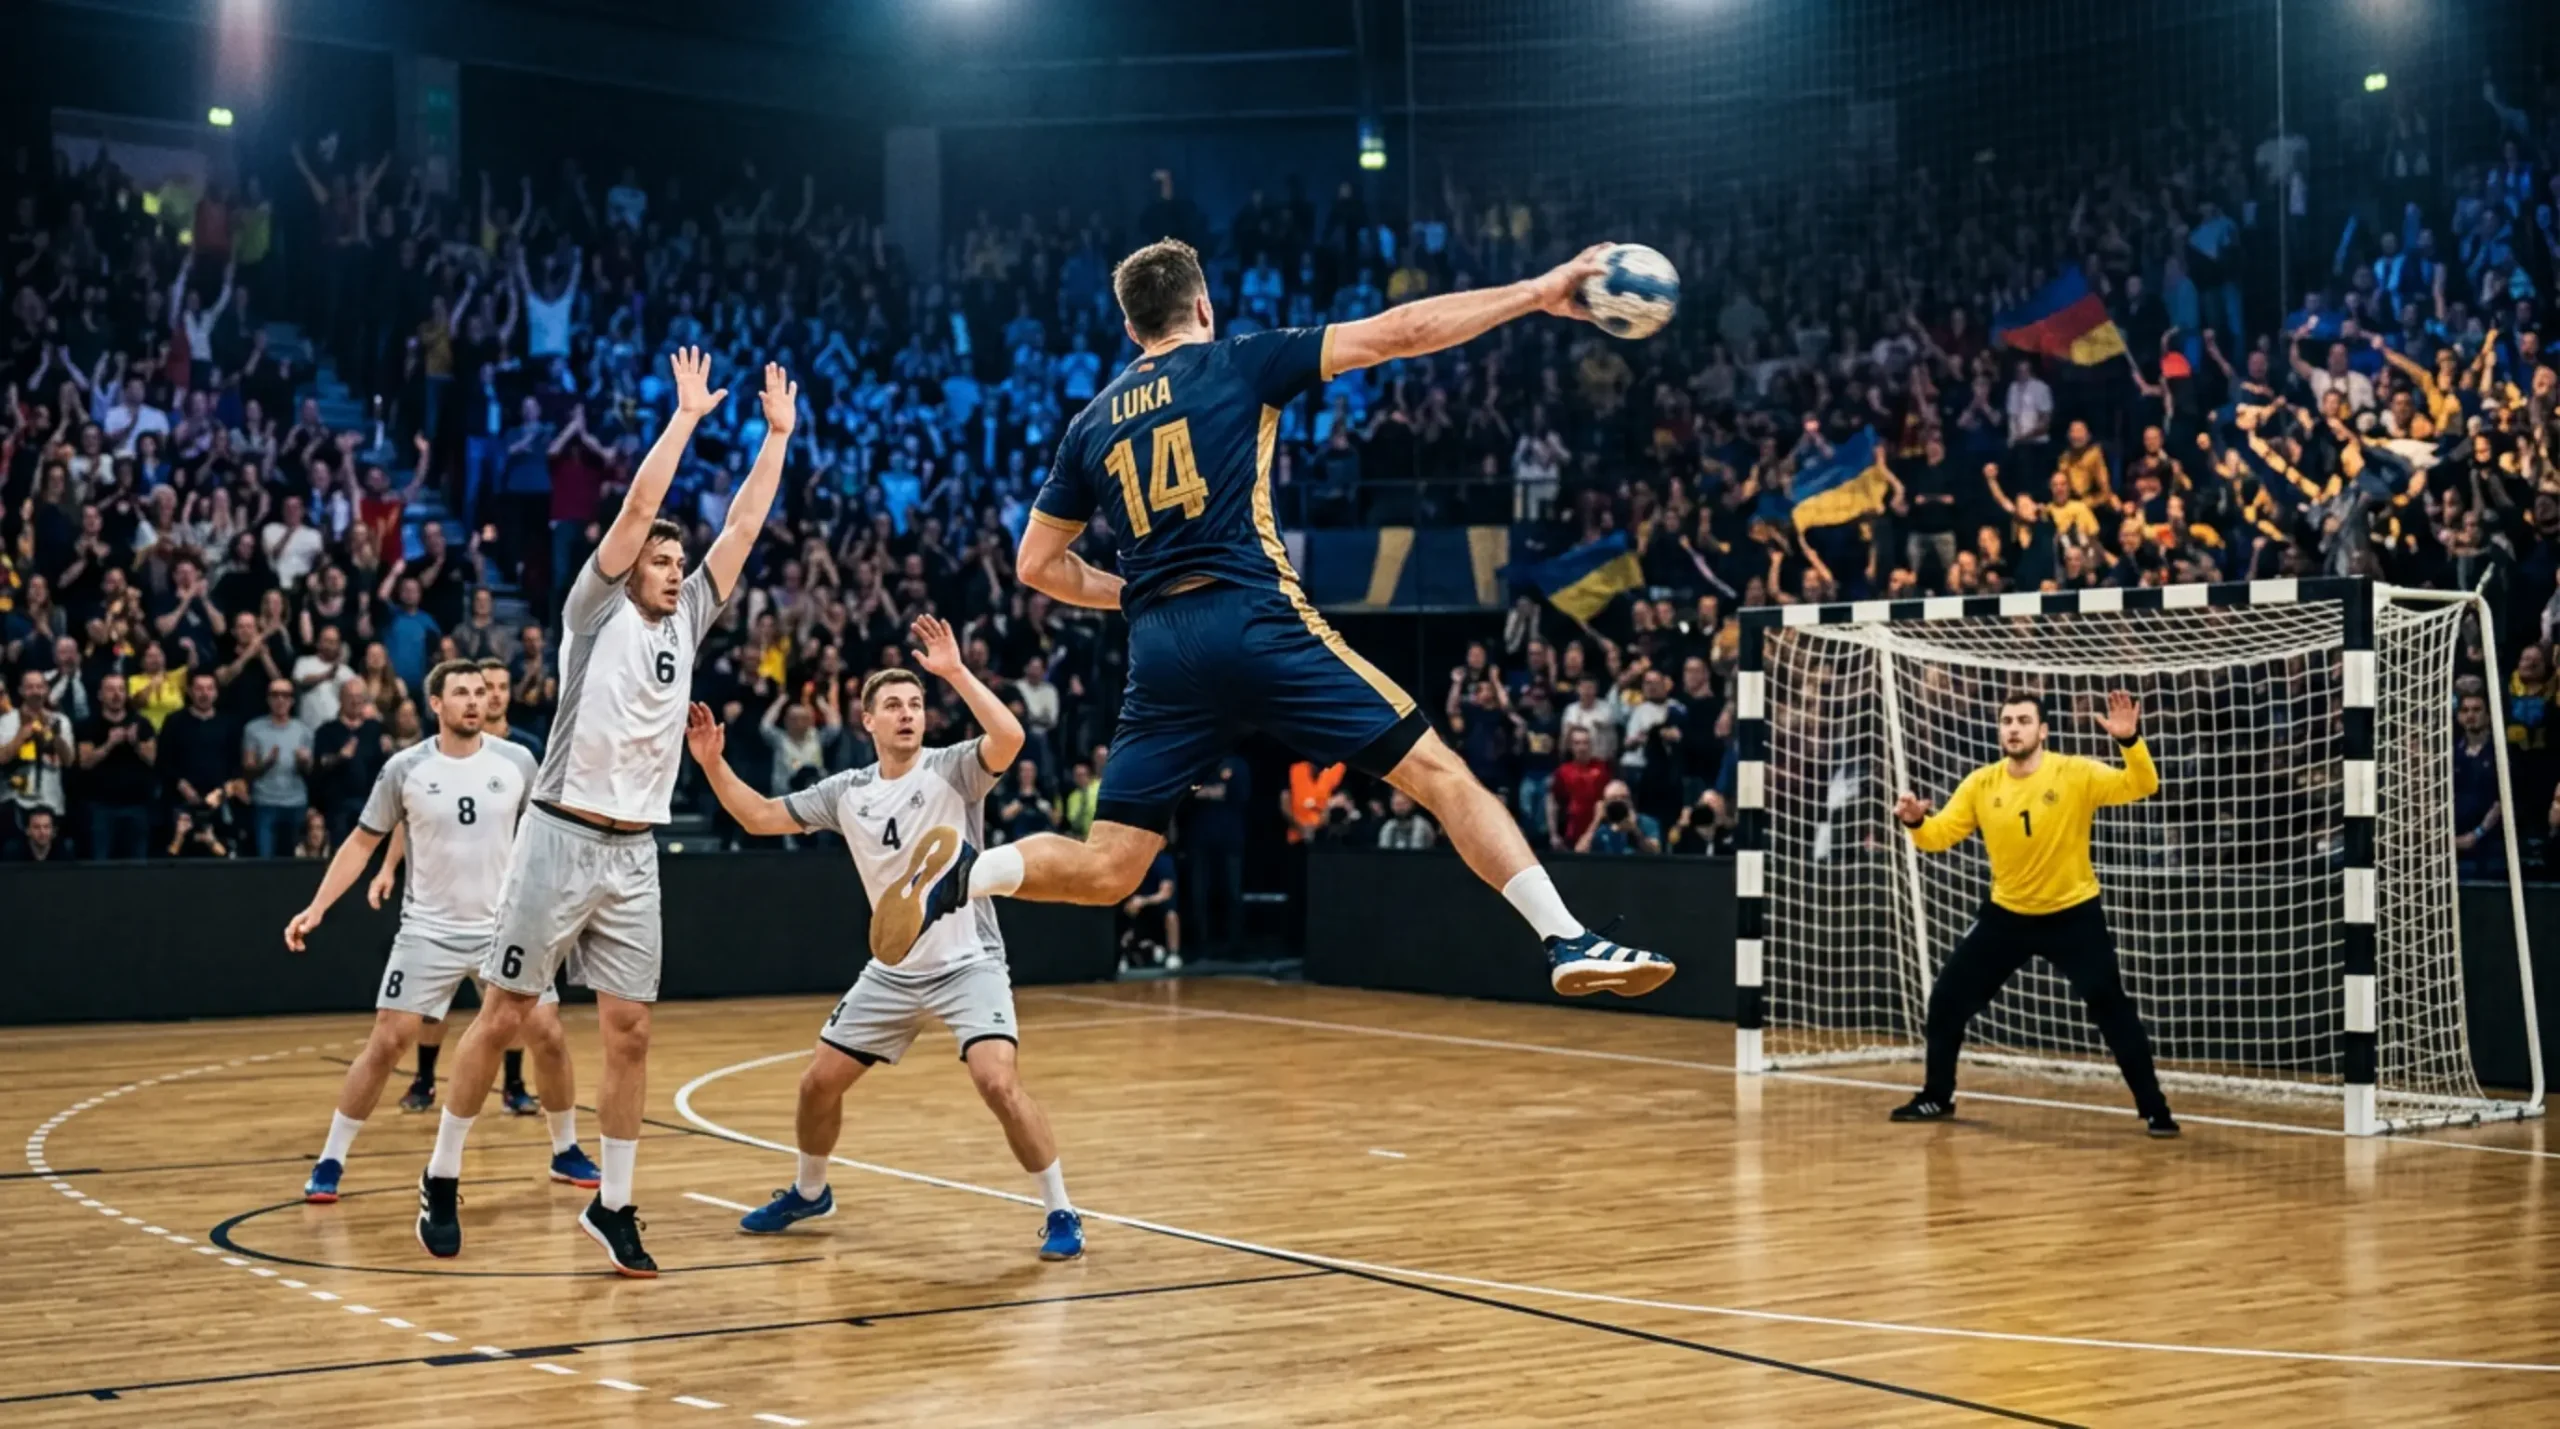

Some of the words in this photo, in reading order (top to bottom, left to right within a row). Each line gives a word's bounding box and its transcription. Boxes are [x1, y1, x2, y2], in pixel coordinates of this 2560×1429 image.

[1111, 376, 1172, 425] LUKA
[1104, 417, 1209, 538] 14
[656, 651, 676, 684] 6
[458, 796, 477, 825] 8
[2019, 809, 2032, 838] 1
[882, 817, 901, 850] 4
[501, 944, 525, 979] 6
[385, 970, 404, 998] 8
